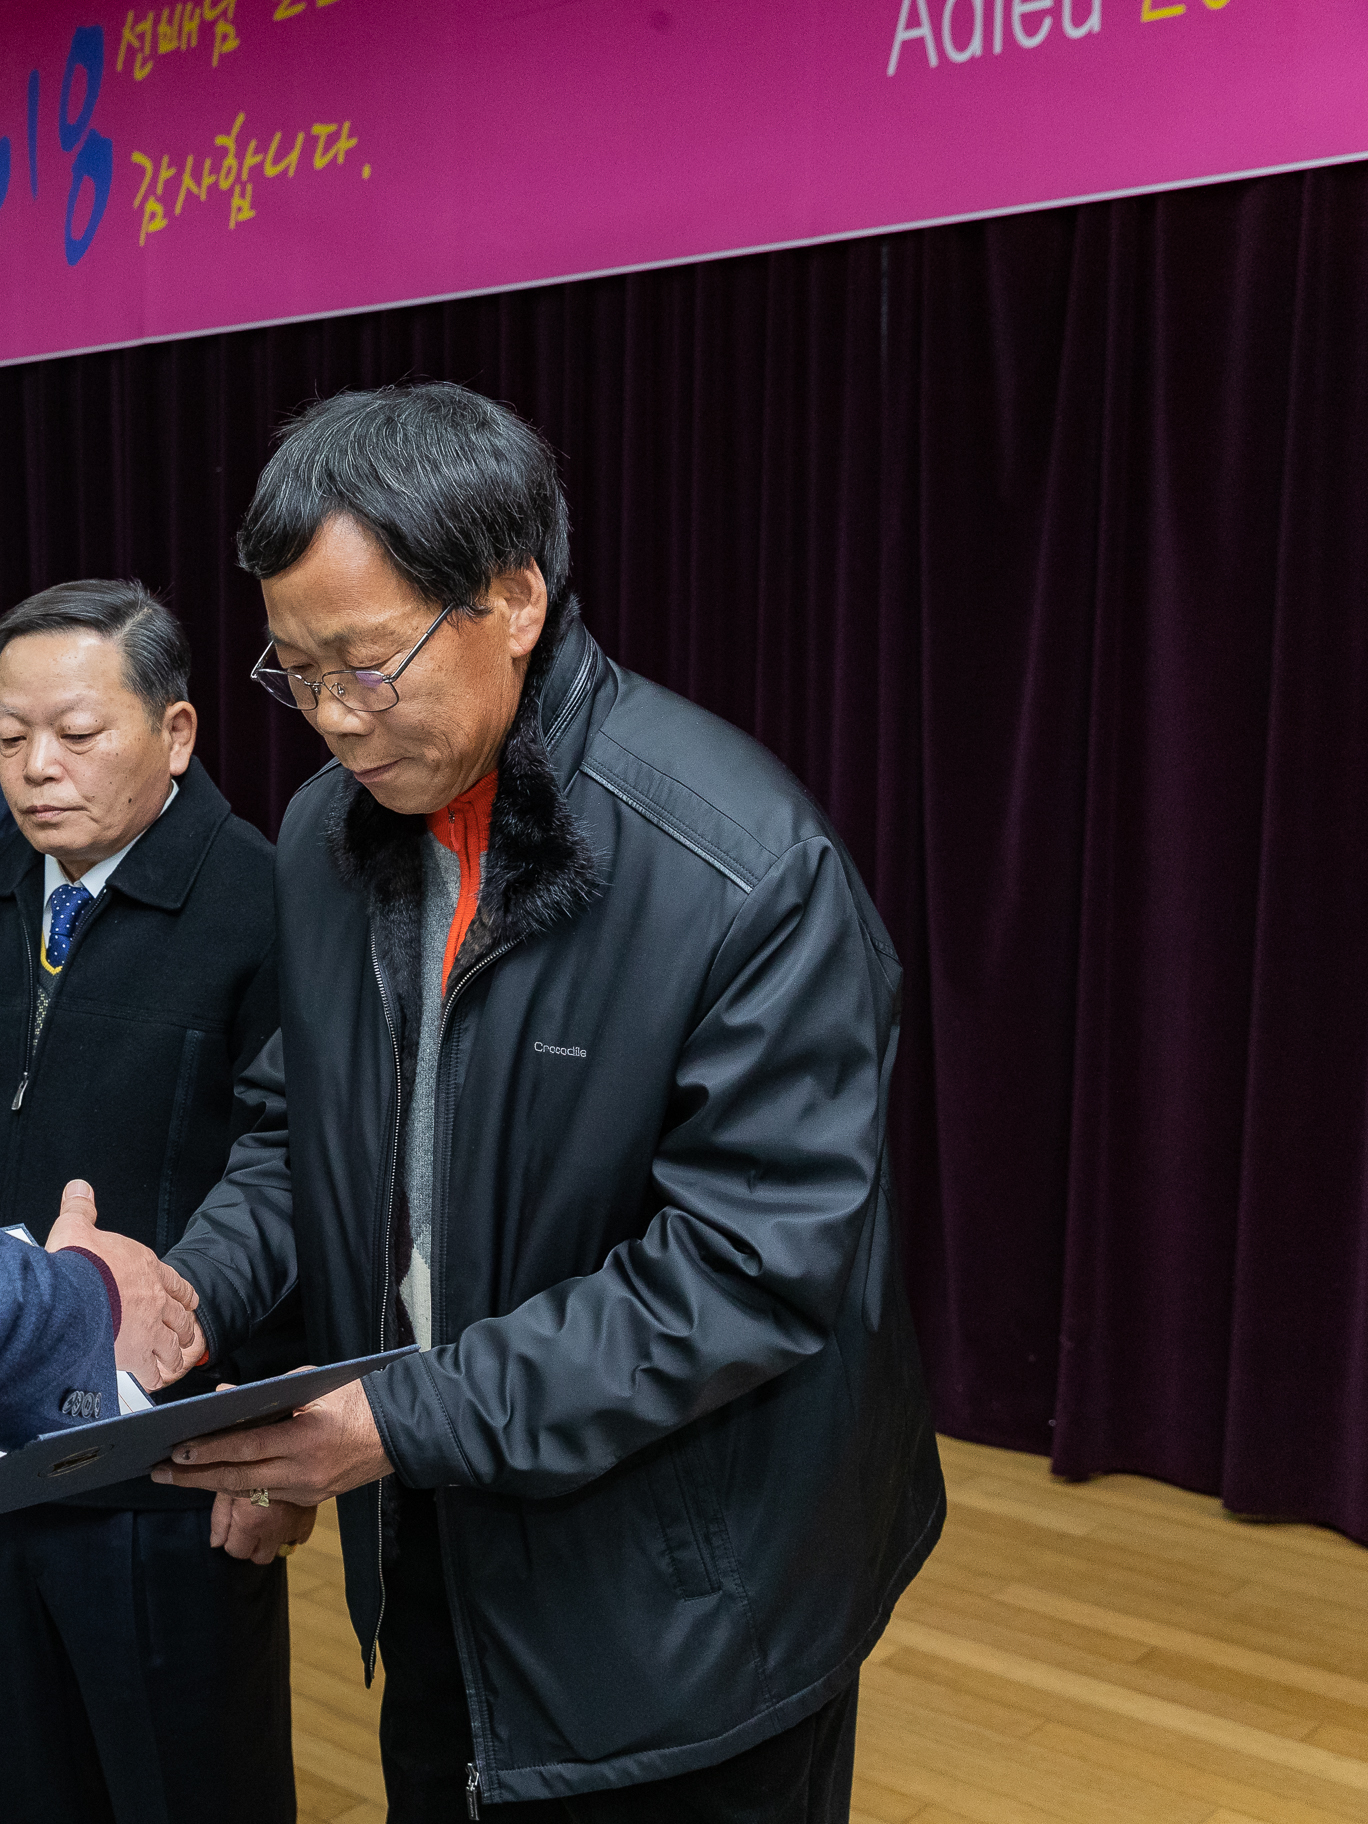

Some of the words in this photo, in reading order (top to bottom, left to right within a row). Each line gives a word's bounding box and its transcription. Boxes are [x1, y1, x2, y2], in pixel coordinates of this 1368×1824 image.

[116, 0, 240, 81] 선배님
[132, 112, 371, 246] 감사합니다.
[534, 1041, 587, 1058] Crocodile
